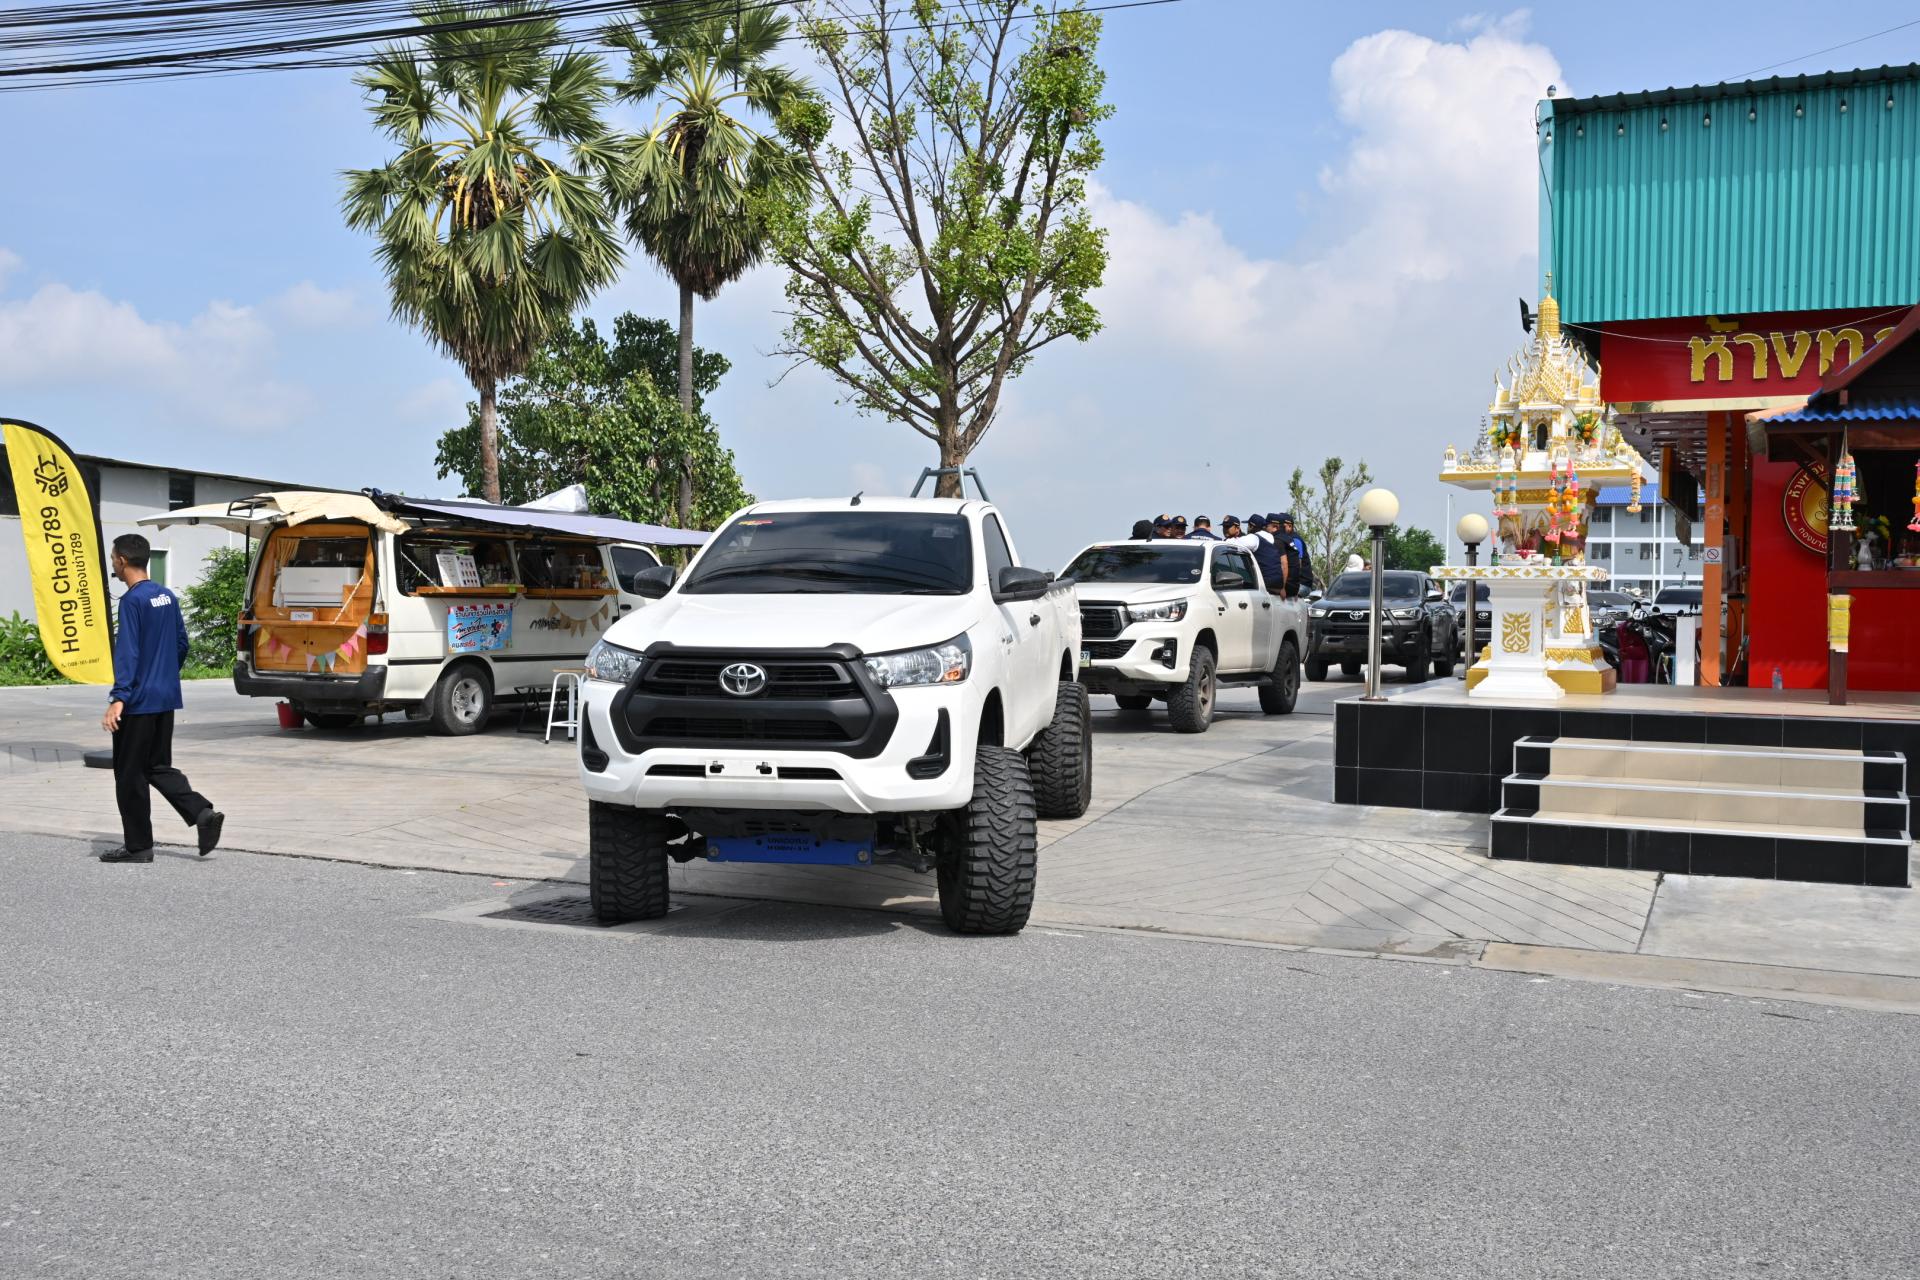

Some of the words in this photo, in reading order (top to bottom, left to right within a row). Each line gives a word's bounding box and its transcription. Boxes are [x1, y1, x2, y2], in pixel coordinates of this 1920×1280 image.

[1688, 316, 1897, 382] ห้างท
[35, 475, 69, 497] 789
[40, 506, 71, 594] Chao789
[69, 532, 94, 628] กาแฟห้องเช่า789
[60, 599, 80, 654] Hong
